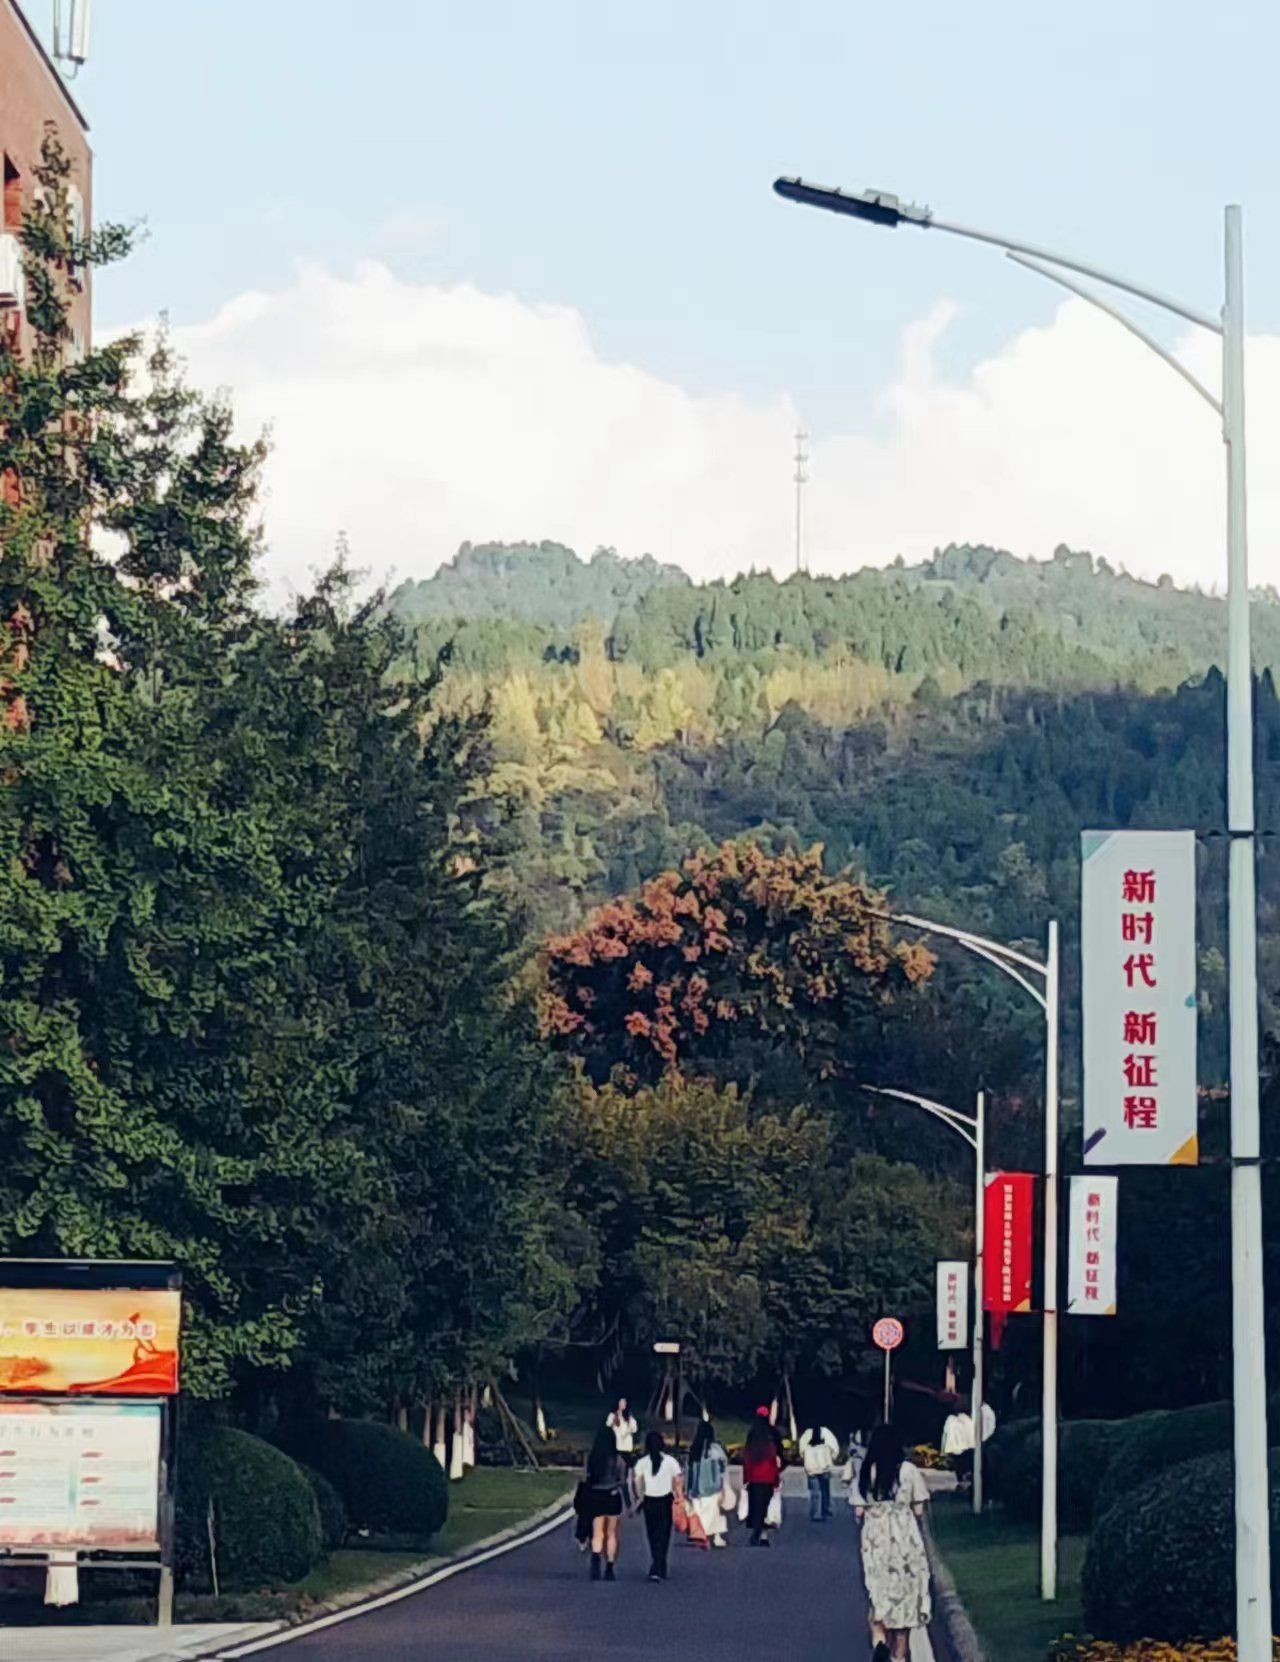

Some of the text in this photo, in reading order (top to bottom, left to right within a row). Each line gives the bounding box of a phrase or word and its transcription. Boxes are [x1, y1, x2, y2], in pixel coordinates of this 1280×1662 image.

[1121, 868, 1158, 1130] 新时代 新征程
